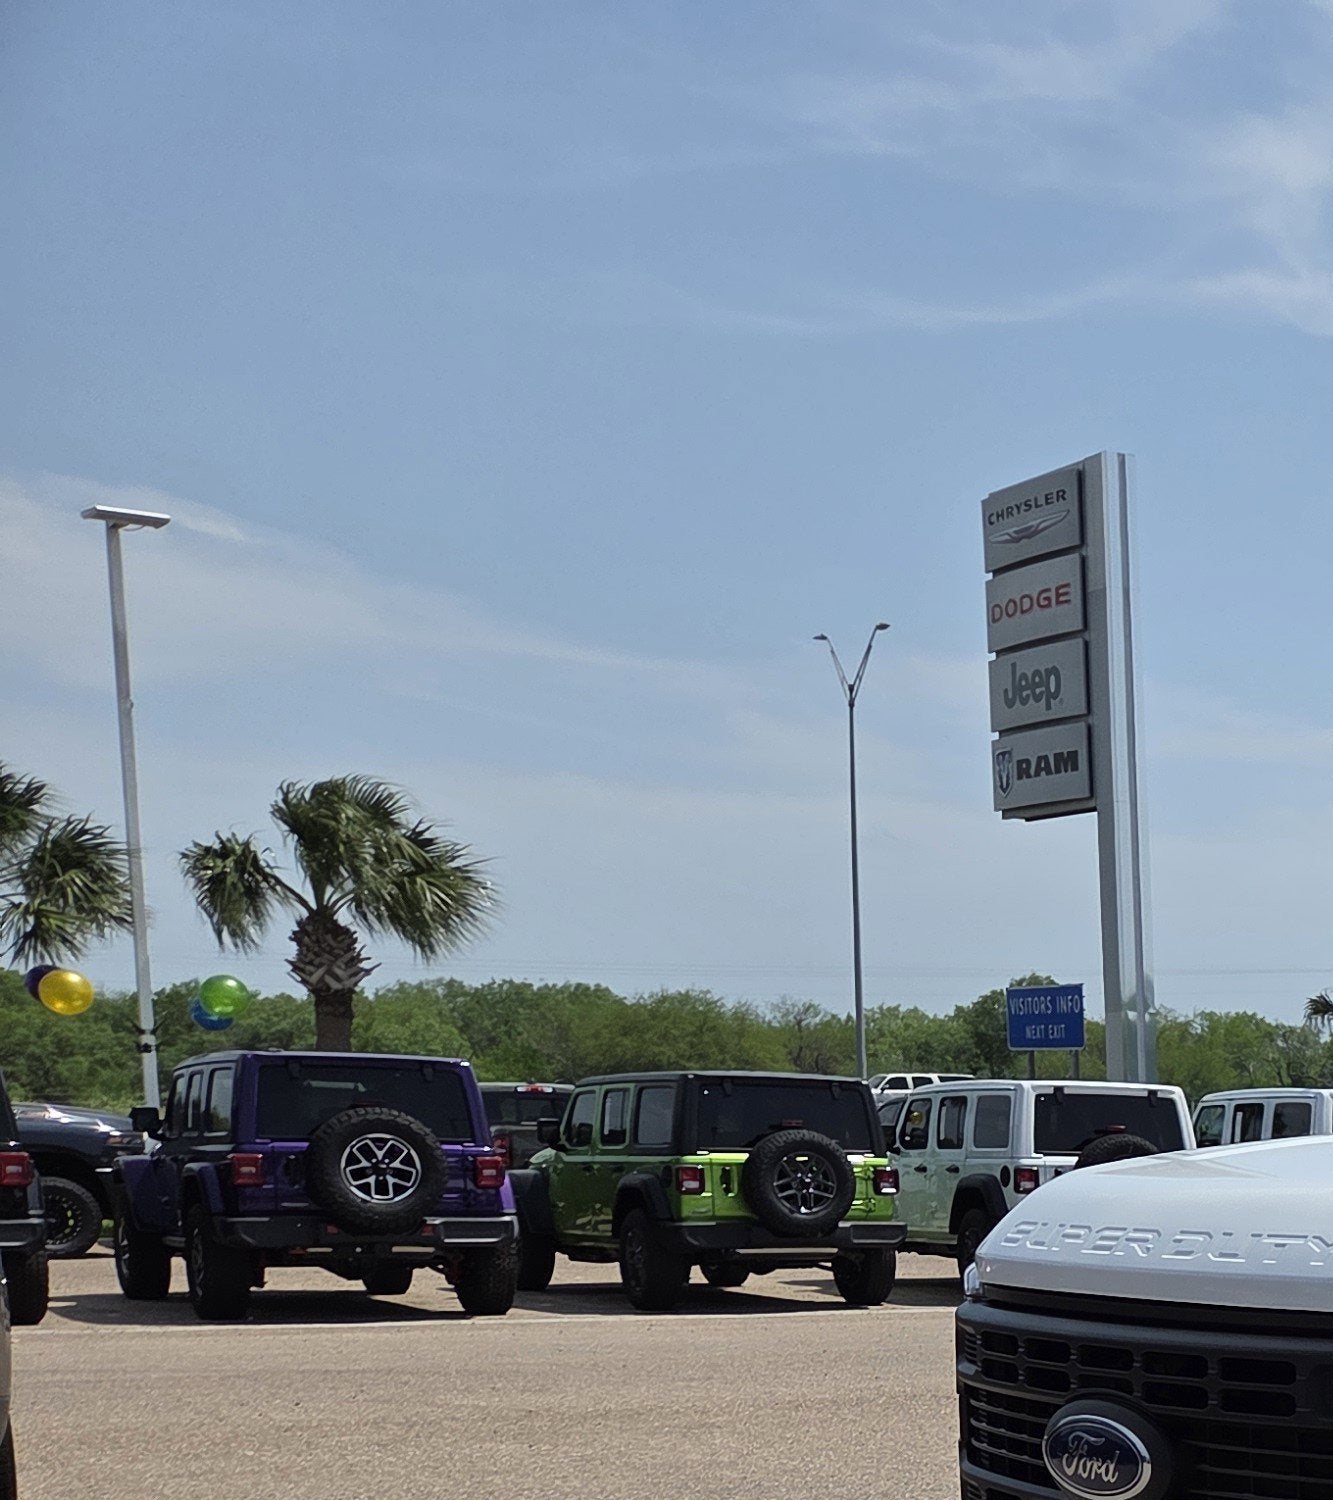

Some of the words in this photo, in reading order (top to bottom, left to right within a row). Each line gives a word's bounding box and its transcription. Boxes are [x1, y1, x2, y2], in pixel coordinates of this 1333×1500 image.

[987, 488, 1068, 526] CHRYSLER
[990, 582, 1072, 625] DODGE
[1003, 662, 1062, 711] Jeep
[1016, 749, 1079, 781] RAM
[1009, 996, 1053, 1016] VISITORS
[1056, 994, 1081, 1014] INFO
[1025, 1024, 1045, 1039] NEXT
[1048, 1024, 1066, 1039] EXIT
[1000, 1220, 1163, 1258] SUPER
[1061, 1430, 1121, 1485] Ford
